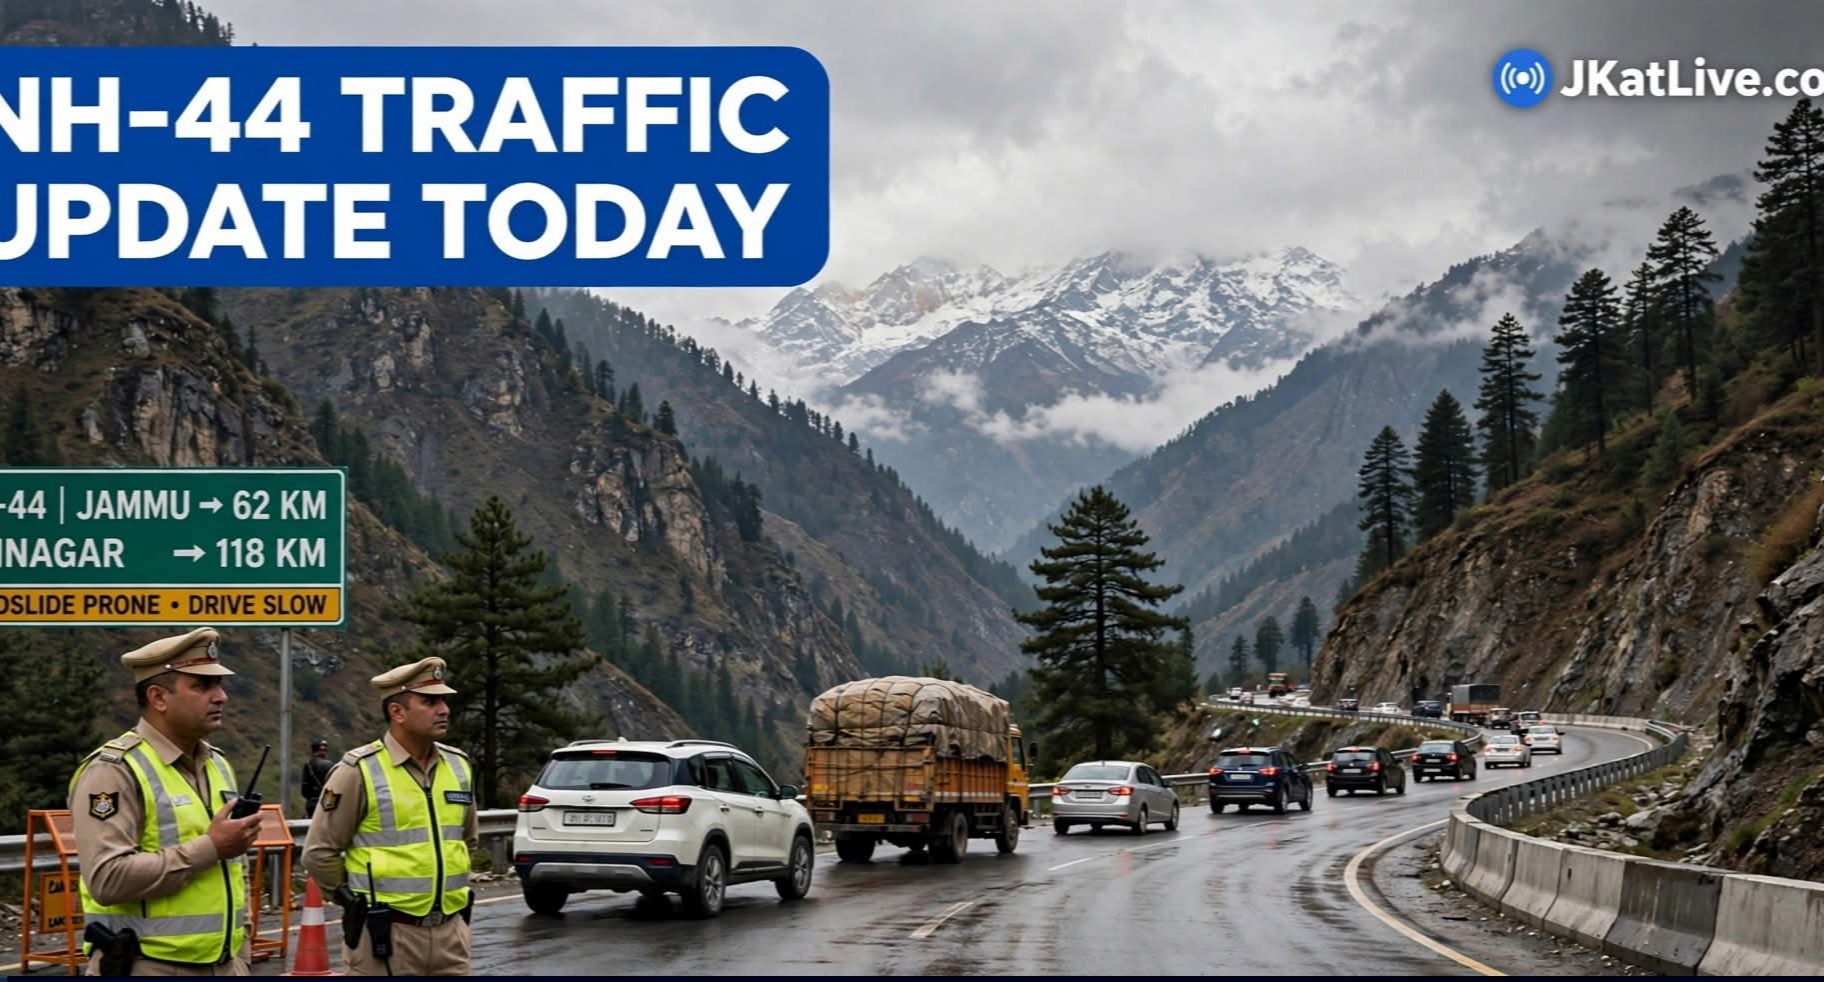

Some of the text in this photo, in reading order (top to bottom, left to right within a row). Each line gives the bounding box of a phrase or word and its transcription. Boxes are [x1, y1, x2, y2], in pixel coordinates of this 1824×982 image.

[76, 490, 190, 519] JAMMU
[233, 490, 270, 519] 62
[281, 490, 326, 519] KM
[216, 538, 265, 567] 118
[277, 538, 326, 567] KM
[84, 595, 160, 615] PRONE
[189, 595, 255, 615] DRIVE
[263, 595, 327, 615] SLOW
